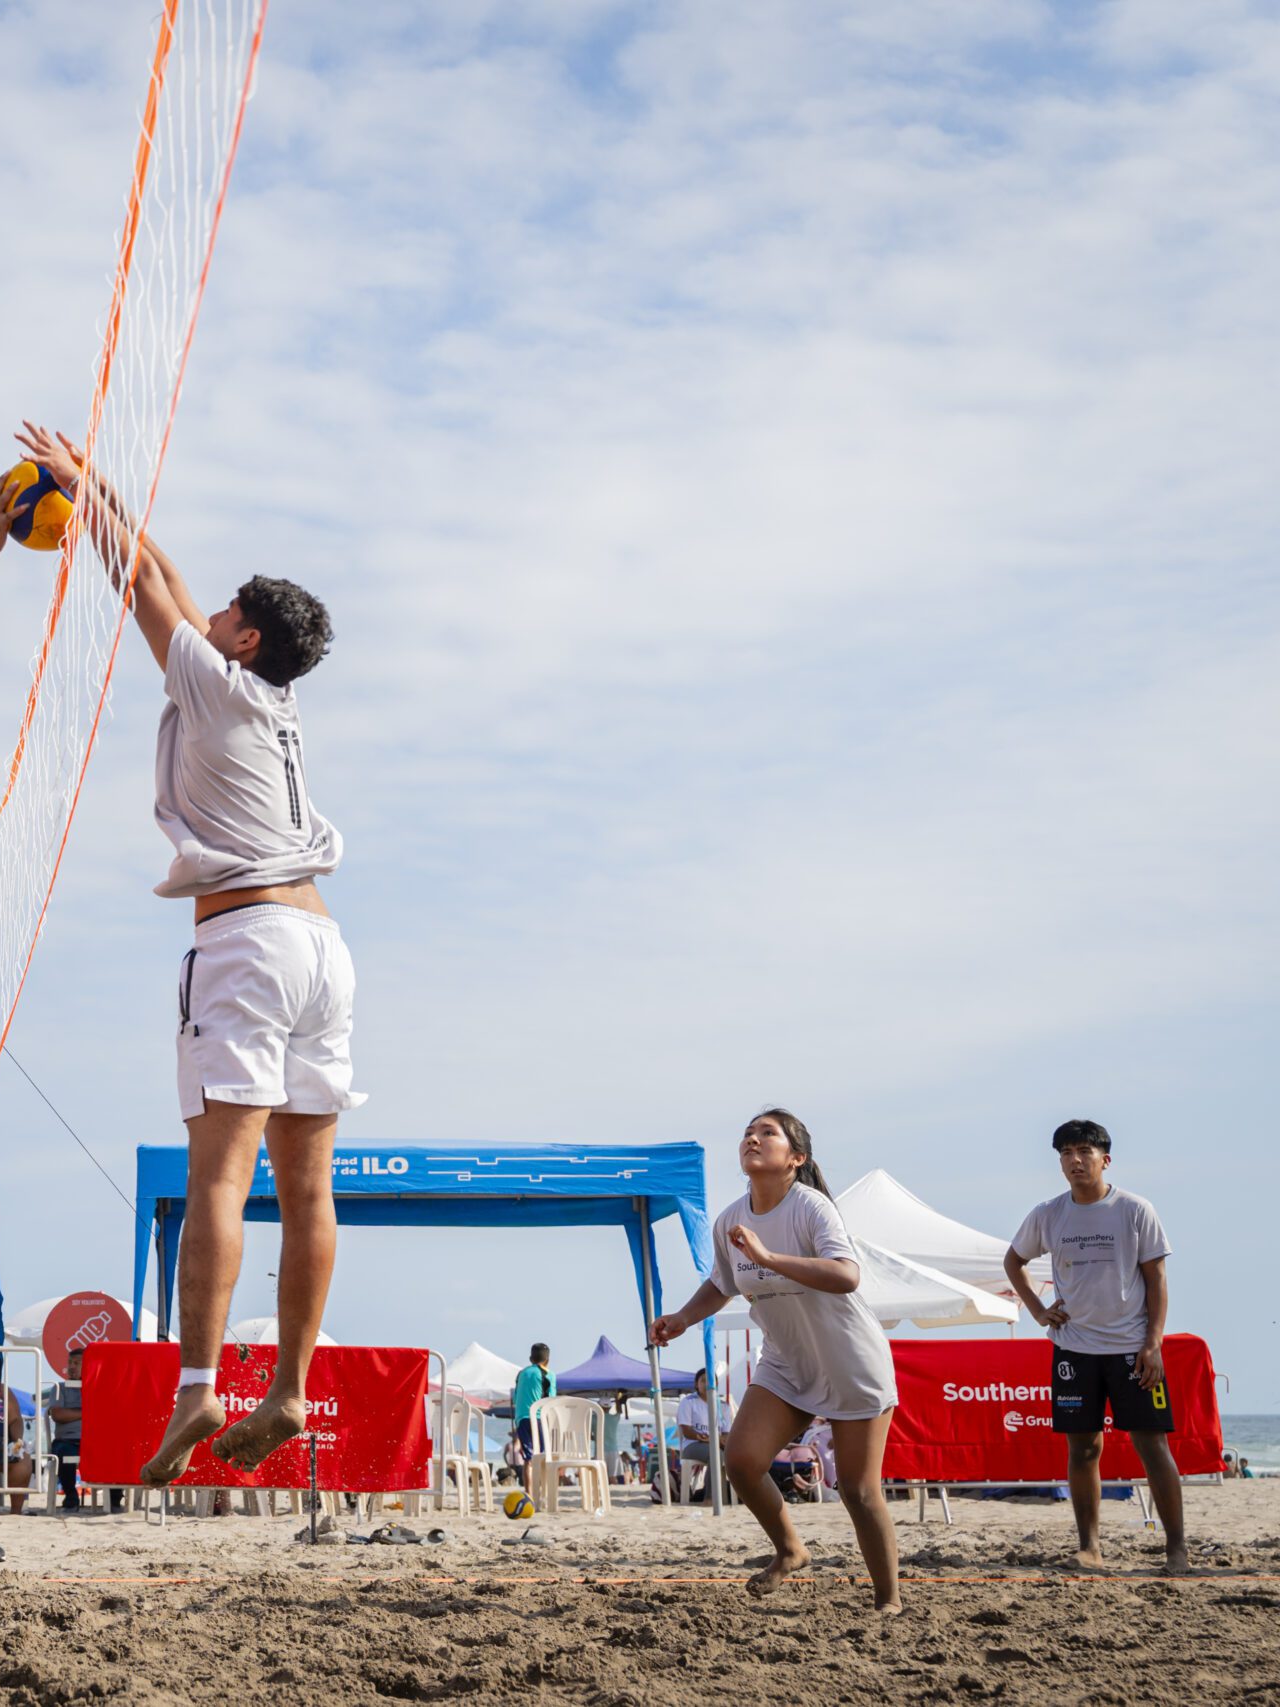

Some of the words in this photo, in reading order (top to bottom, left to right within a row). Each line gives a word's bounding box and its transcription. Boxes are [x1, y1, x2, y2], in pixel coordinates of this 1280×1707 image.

[341, 1167, 358, 1175] de
[362, 1157, 409, 1175] ILO
[943, 1382, 1052, 1402] Southern
